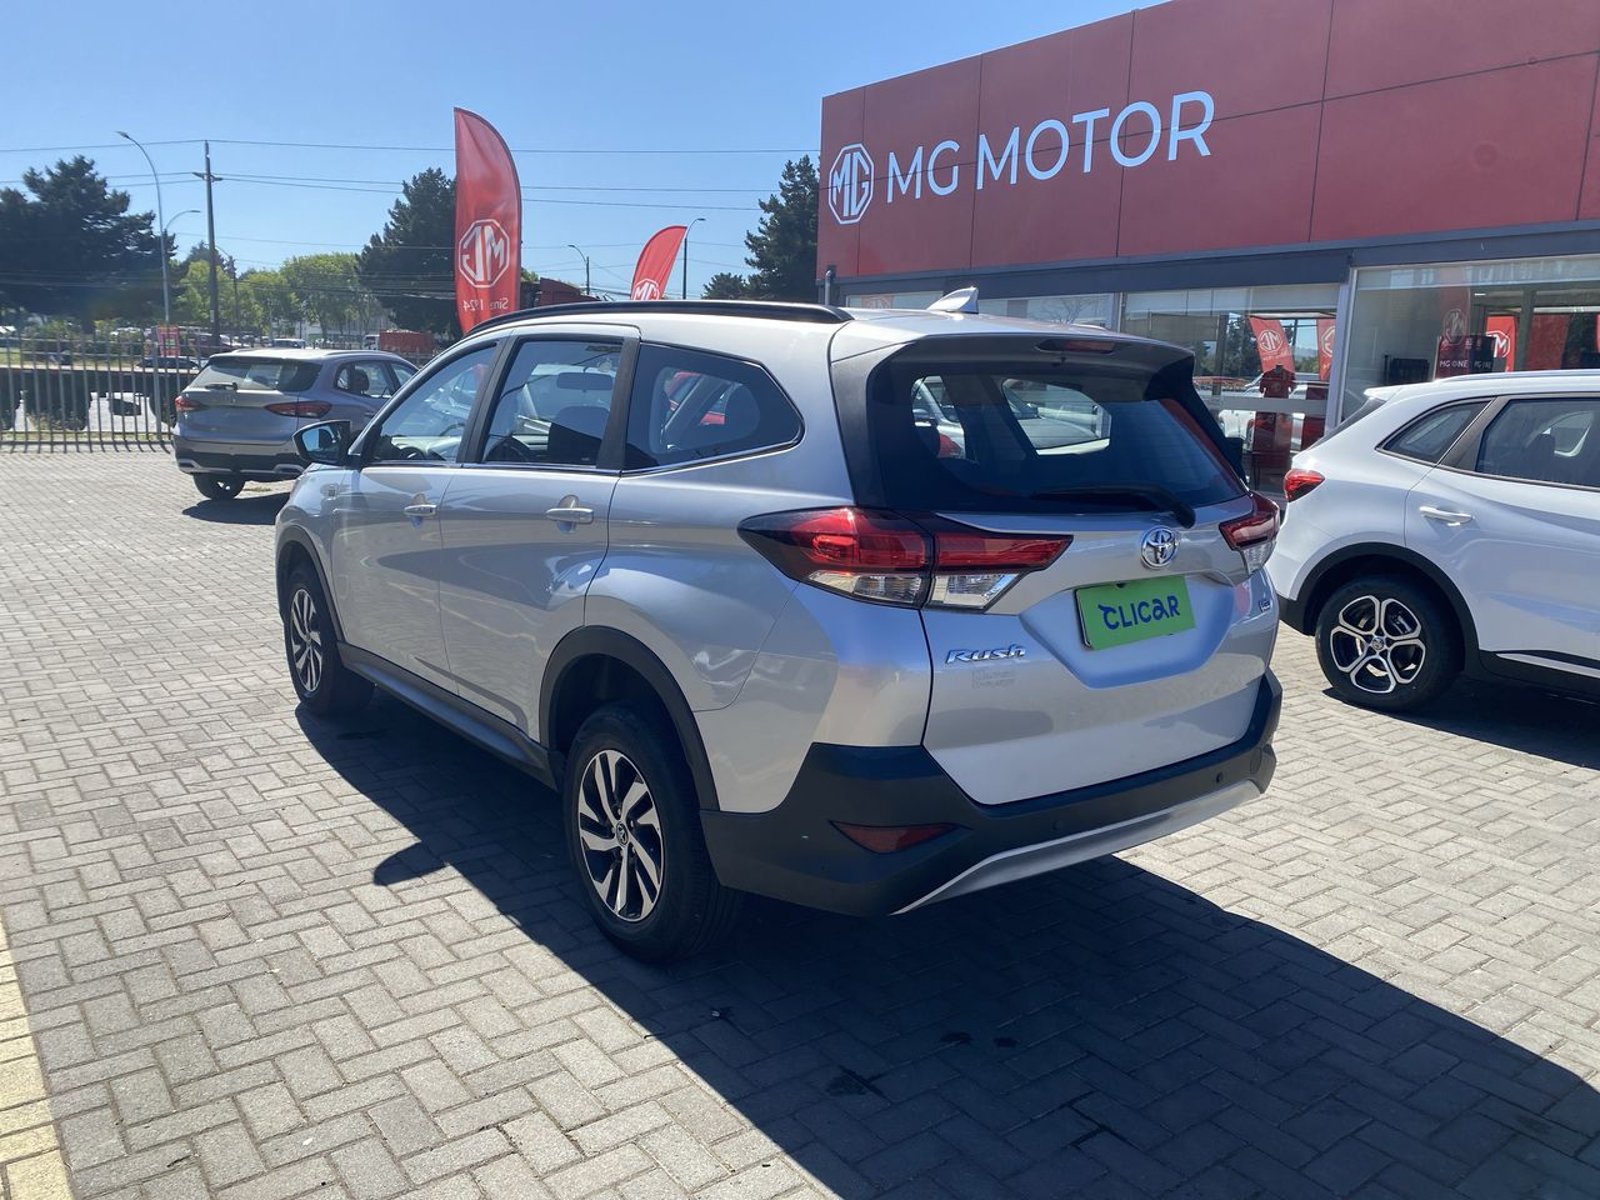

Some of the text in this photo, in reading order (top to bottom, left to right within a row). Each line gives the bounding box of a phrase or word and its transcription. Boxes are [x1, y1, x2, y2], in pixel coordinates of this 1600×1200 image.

[831, 90, 1215, 218] MG MG MOTOR
[945, 643, 1026, 664] Rush
